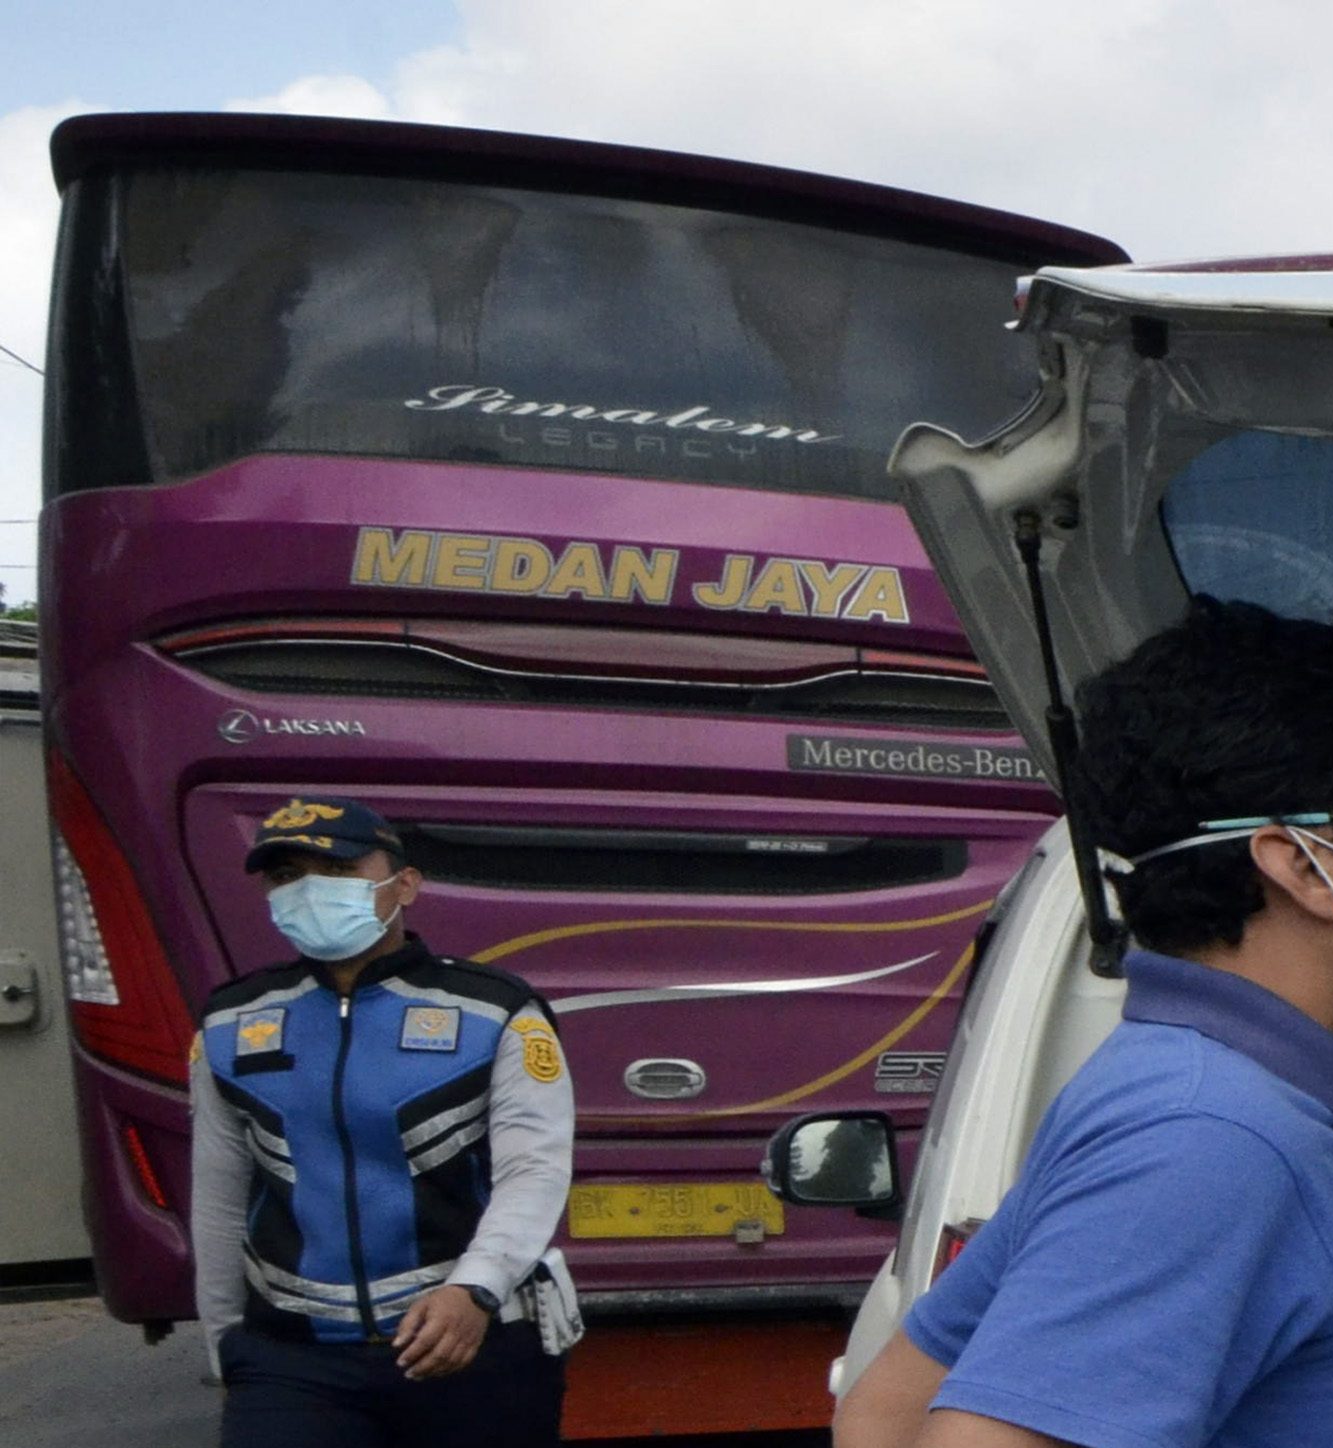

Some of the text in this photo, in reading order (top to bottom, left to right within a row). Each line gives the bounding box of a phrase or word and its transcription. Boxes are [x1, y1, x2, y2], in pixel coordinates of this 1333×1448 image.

[499, 425, 758, 461] LEGACY
[350, 526, 910, 624] MEDAN JAYA
[263, 717, 367, 736] LAKSANA
[802, 738, 1047, 779] Mercedes-Ben
